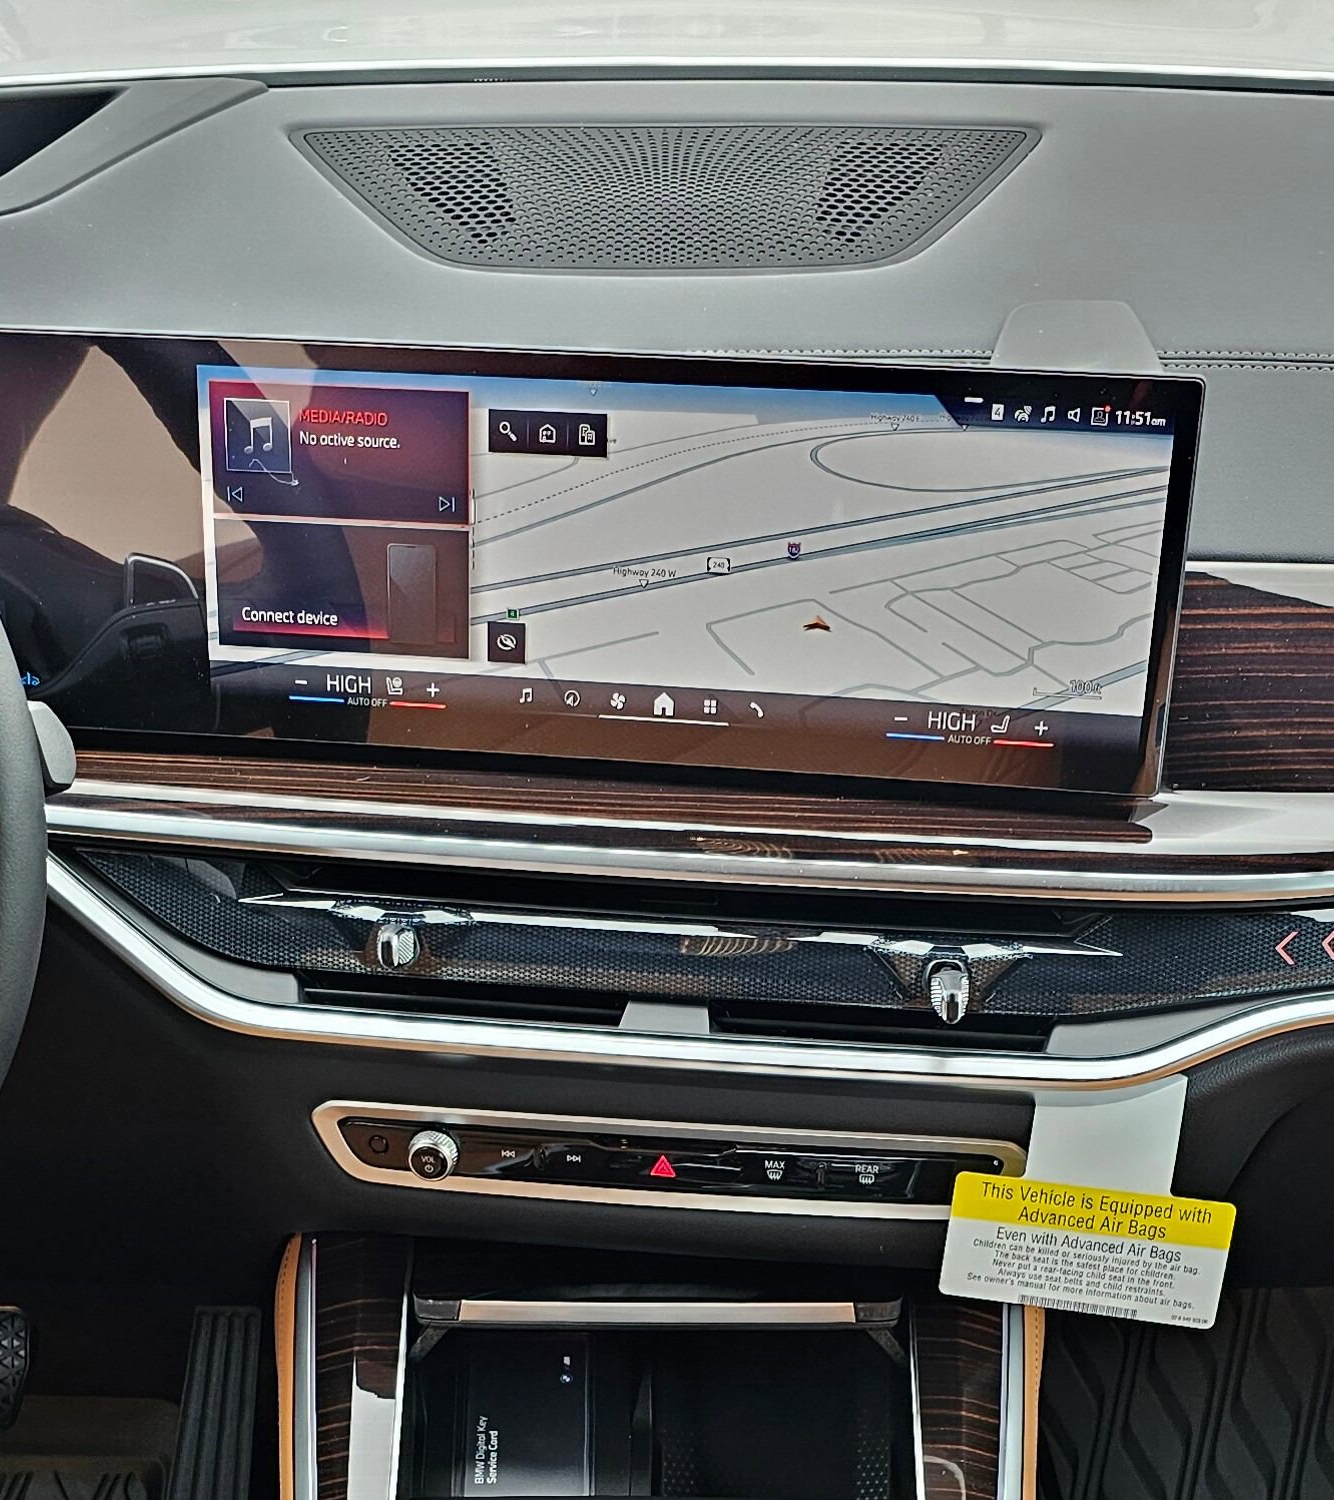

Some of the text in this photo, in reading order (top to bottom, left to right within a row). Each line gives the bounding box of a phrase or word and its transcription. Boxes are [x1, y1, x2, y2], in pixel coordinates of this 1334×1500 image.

[299, 409, 388, 426] MEDIA/RADIO
[299, 430, 401, 449] No active source.
[613, 567, 677, 578] Highway 240 W
[241, 606, 338, 626] Connect device
[326, 674, 372, 694] HIGH
[347, 697, 388, 708] AUTO OFF
[928, 711, 976, 732] HIGH
[947, 734, 992, 745] AUTO OFF
[421, 1155, 435, 1164] VOL
[764, 1159, 786, 1170] MAX
[855, 1163, 880, 1174] REAR
[982, 1181, 1212, 1224] This Vehicle is Equipped with
[1018, 1206, 1167, 1241] Advanced Air Bags
[996, 1226, 1182, 1263] Even with Advanced Air Bags
[973, 1238, 1201, 1275] Children can be killed or seriously injured by the air bag.
[995, 1250, 1176, 1280] The back seat is the safest place for children.
[992, 1259, 1015, 1268] Never
[1017, 1261, 1031, 1271] put
[1040, 1265, 1084, 1278] rear-facing
[1086, 1270, 1106, 1280] child
[1108, 1273, 1126, 1283] seat
[1127, 1276, 1135, 1285] in
[1137, 1277, 1151, 1287] the
[1152, 1279, 1175, 1290] front.
[997, 1268, 1165, 1297] Always use seat belts and child restraints.
[967, 1271, 1195, 1310] See owner's manual for more information about air bags.
[474, 1415, 488, 1485] BMW Digital Key
[487, 1430, 499, 1484] Service Card
